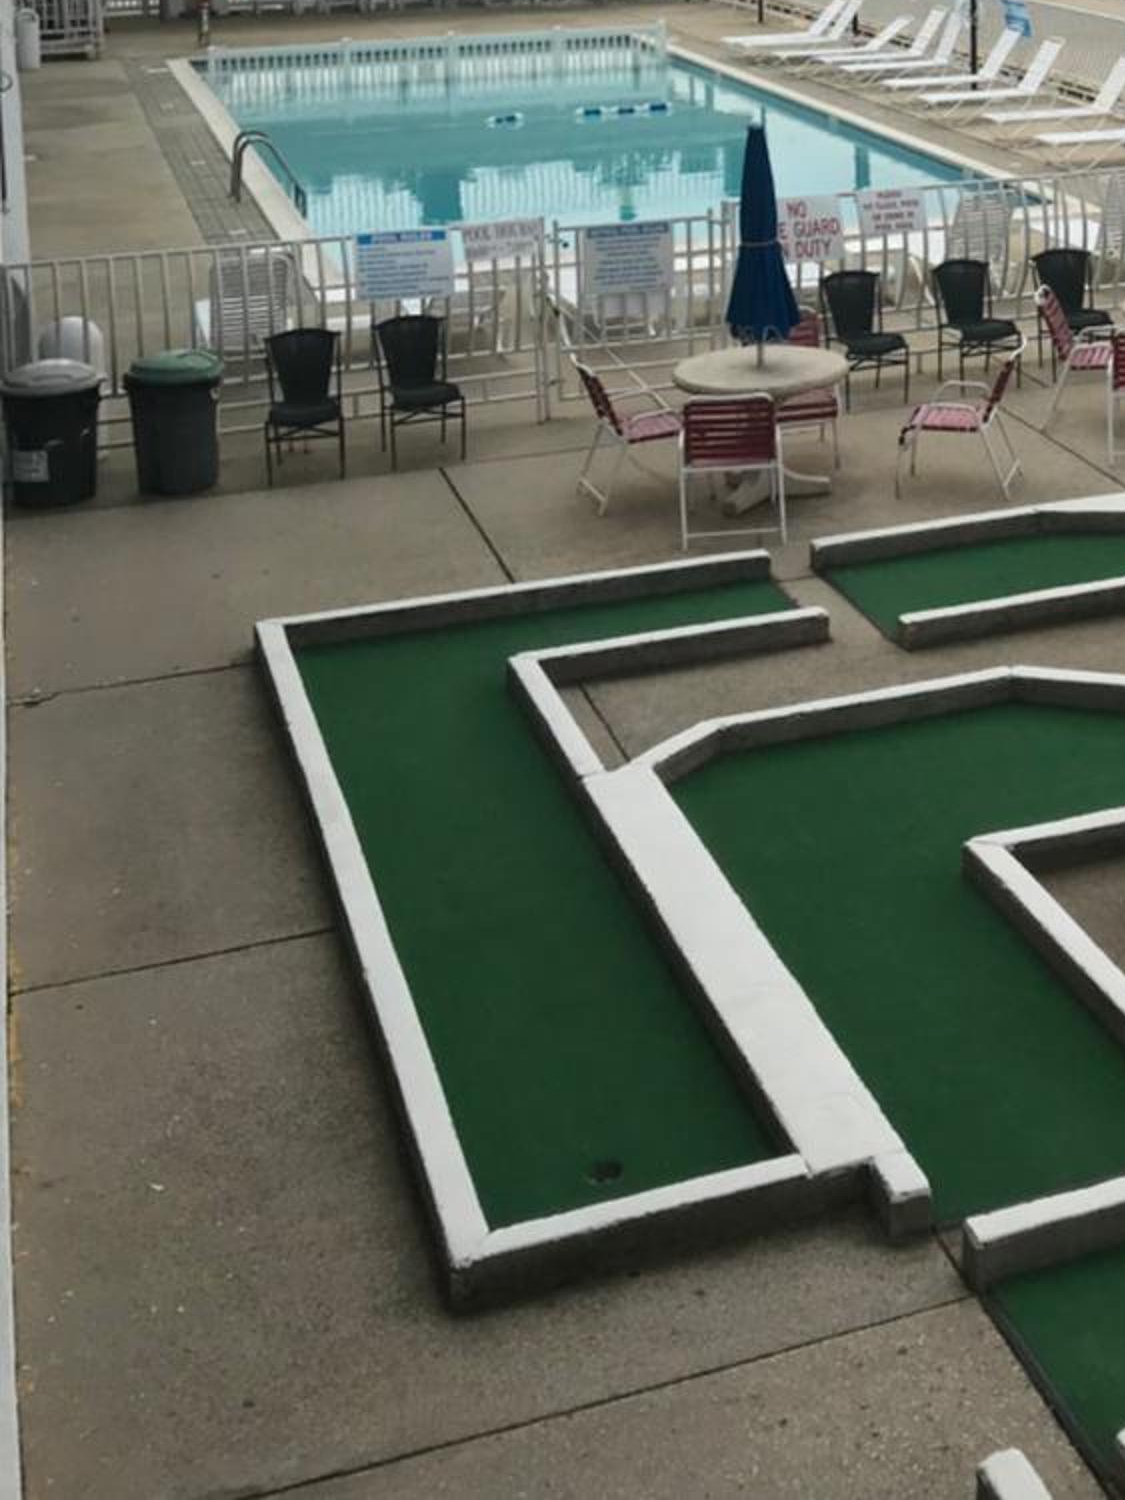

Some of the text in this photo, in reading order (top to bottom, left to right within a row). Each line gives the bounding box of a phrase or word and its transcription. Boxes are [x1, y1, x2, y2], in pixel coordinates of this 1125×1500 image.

[785, 202, 807, 218] NO
[793, 217, 840, 239] GUARD
[795, 238, 832, 259] DUTY
